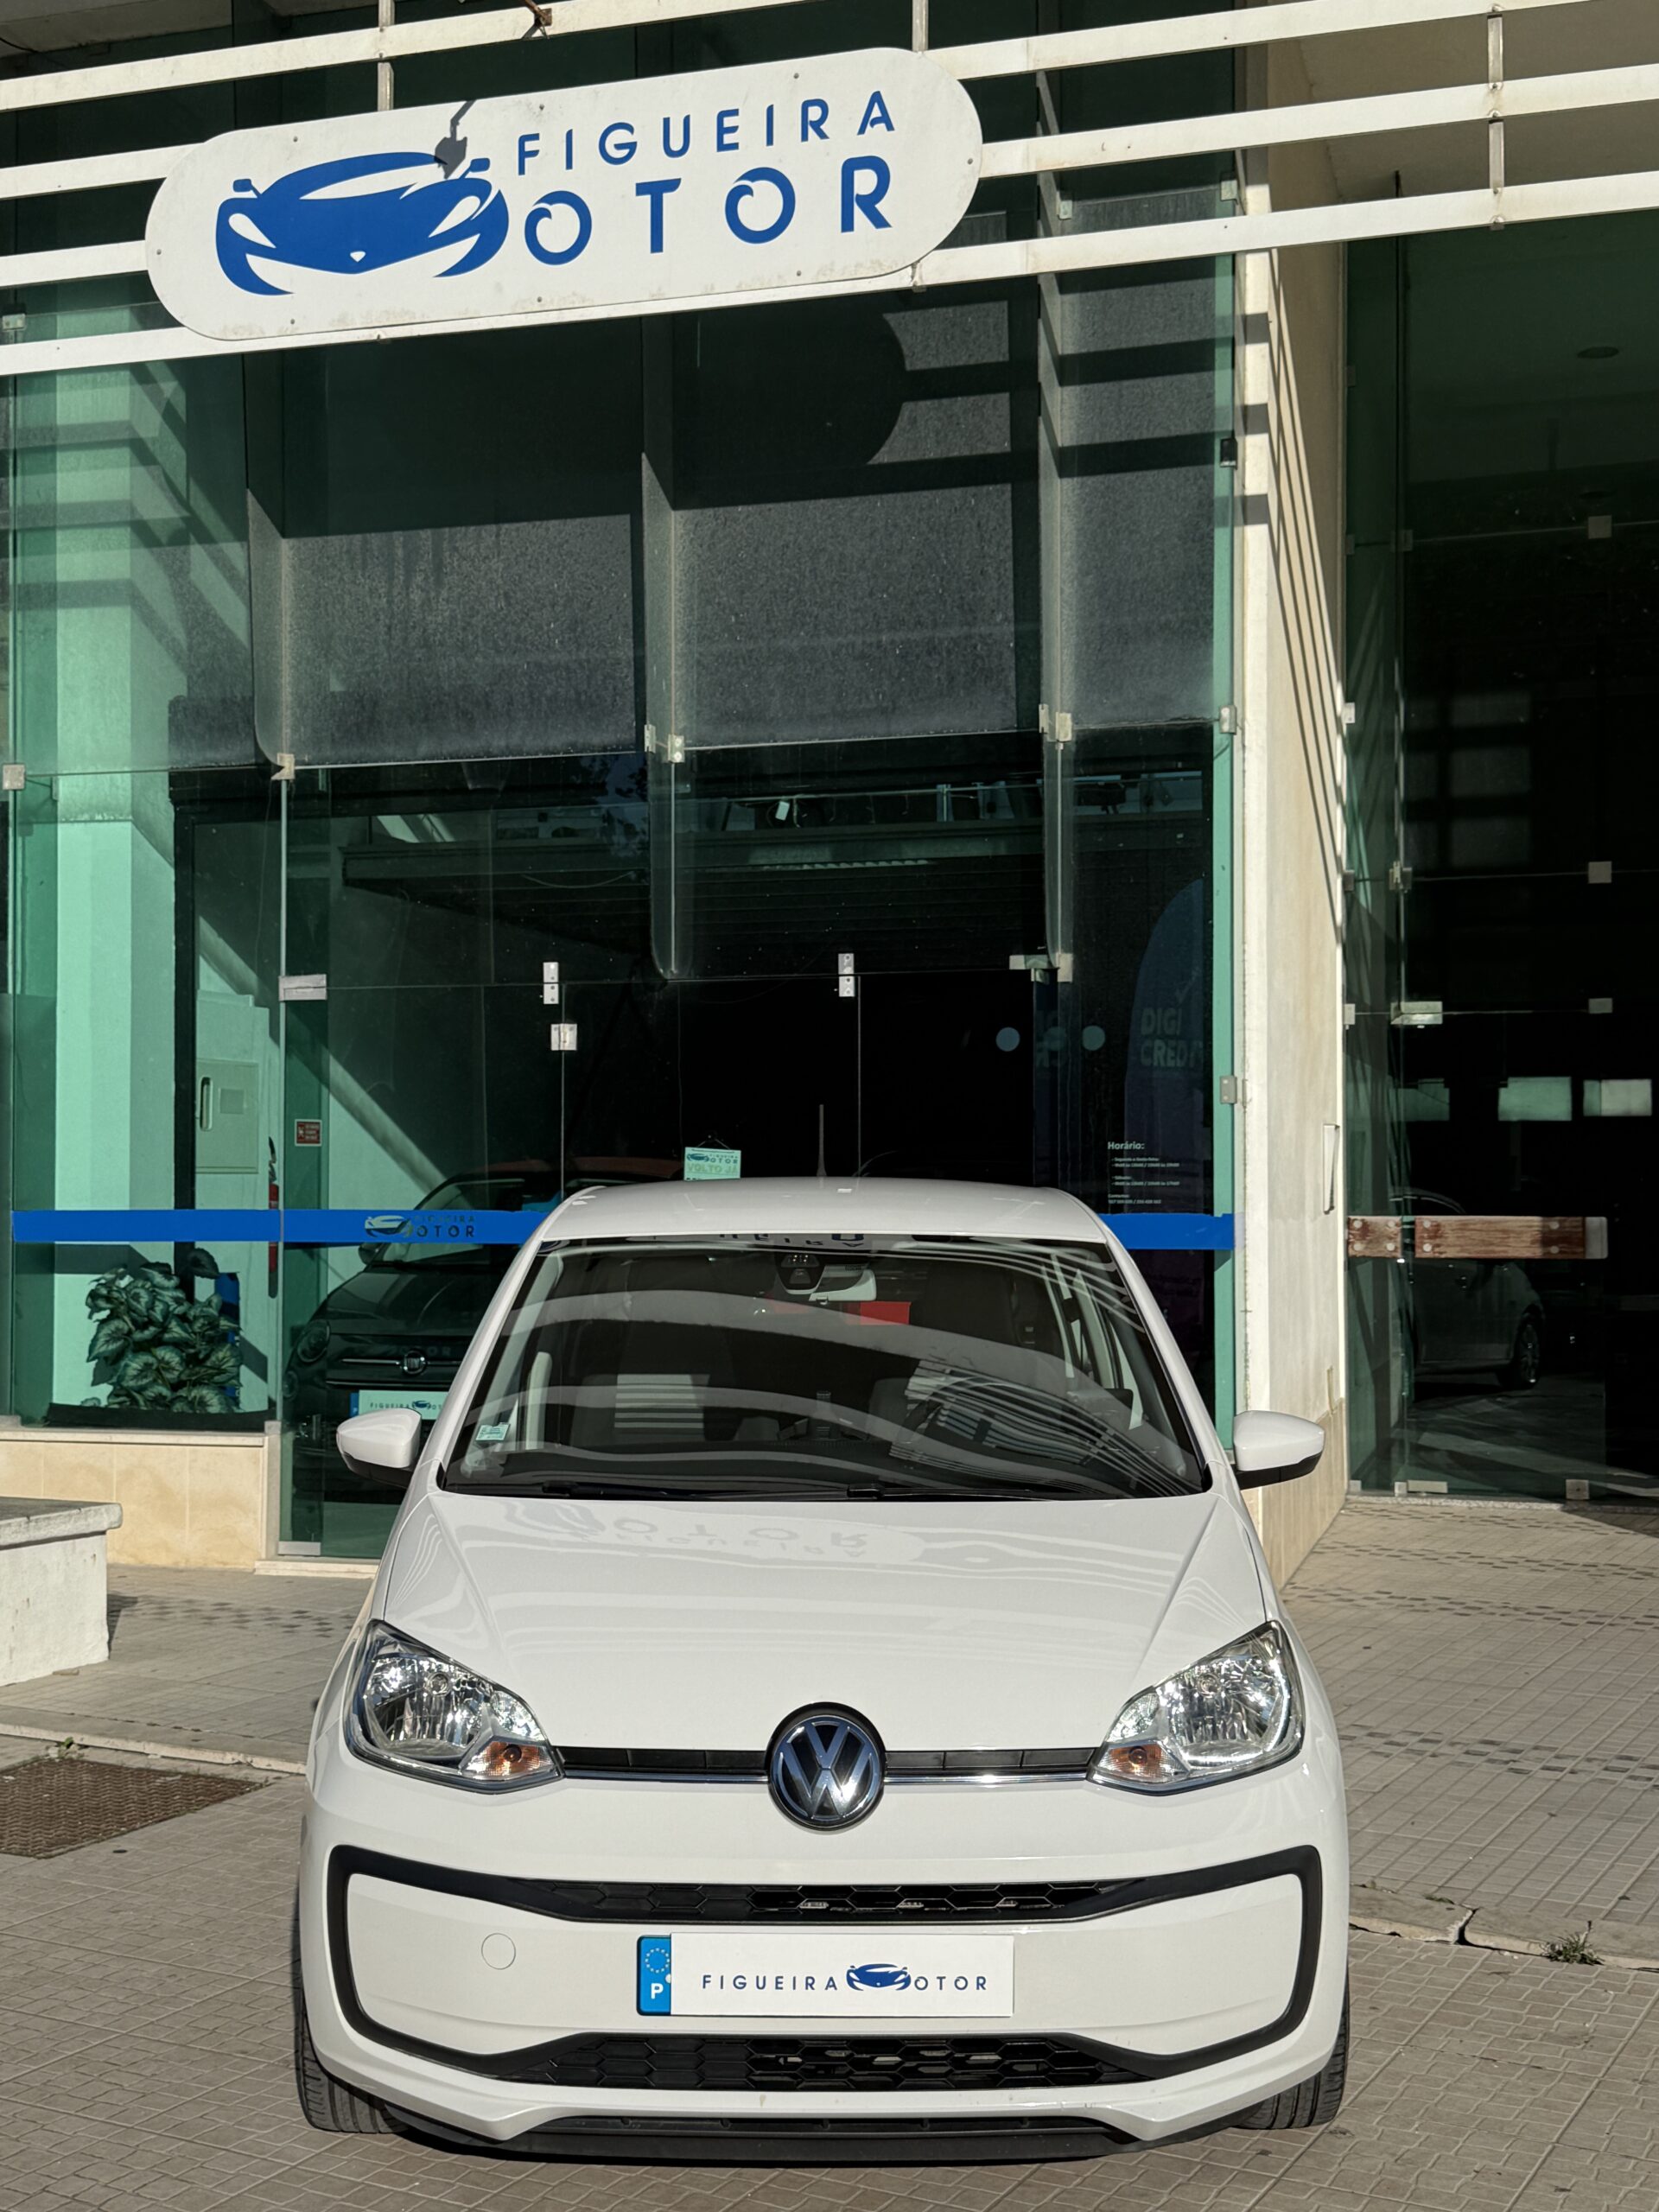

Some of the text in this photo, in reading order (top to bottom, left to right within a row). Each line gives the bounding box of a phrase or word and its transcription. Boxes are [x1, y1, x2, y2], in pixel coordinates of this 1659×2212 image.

[518, 90, 895, 176] FIGUEIRA
[524, 155, 893, 266] OTOR
[1141, 1007, 1183, 1036] DIGI
[1107, 1141, 1146, 1150] Horário:
[416, 1224, 474, 1238] OTOR
[651, 1982, 664, 1999] P
[702, 1974, 988, 1991] FIGUEIRA OTOR
